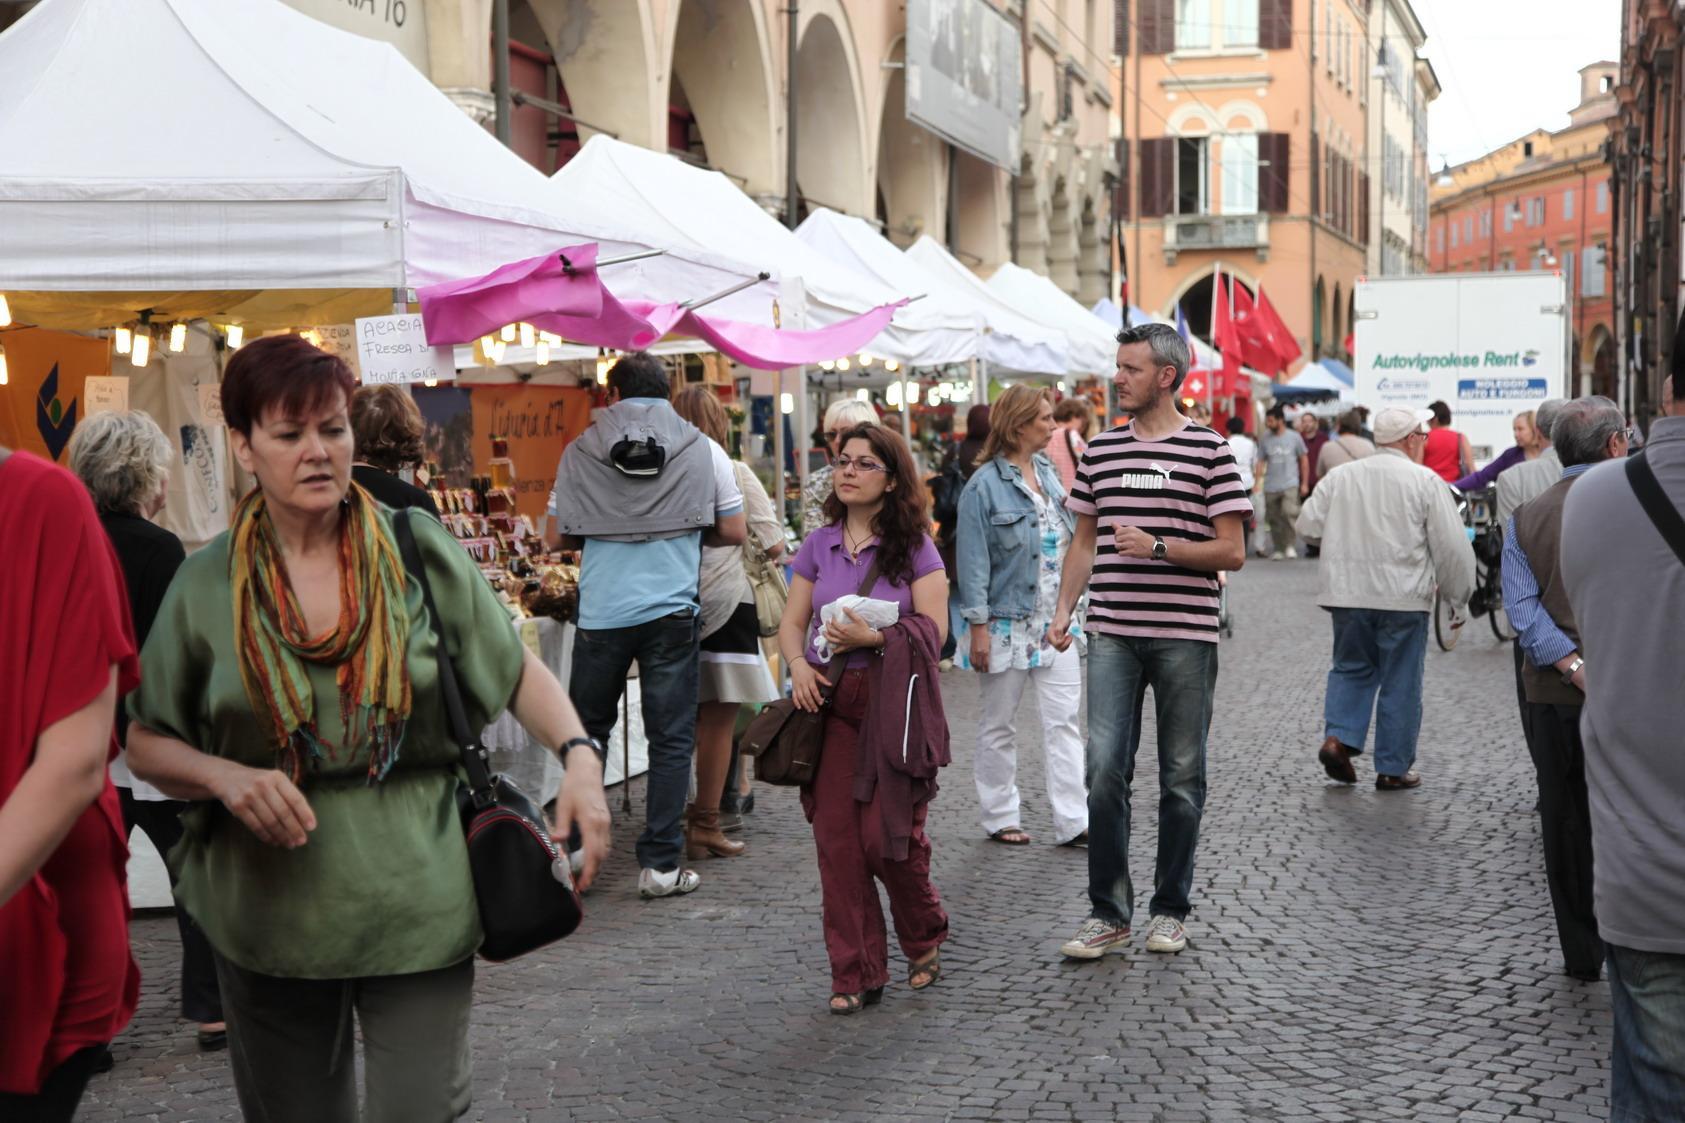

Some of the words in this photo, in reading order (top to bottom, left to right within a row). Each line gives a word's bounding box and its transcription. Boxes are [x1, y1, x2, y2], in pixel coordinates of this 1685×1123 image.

[1373, 353, 1479, 371] Autovignolese
[1484, 352, 1519, 367] Rent
[1121, 473, 1163, 489] PUMA
